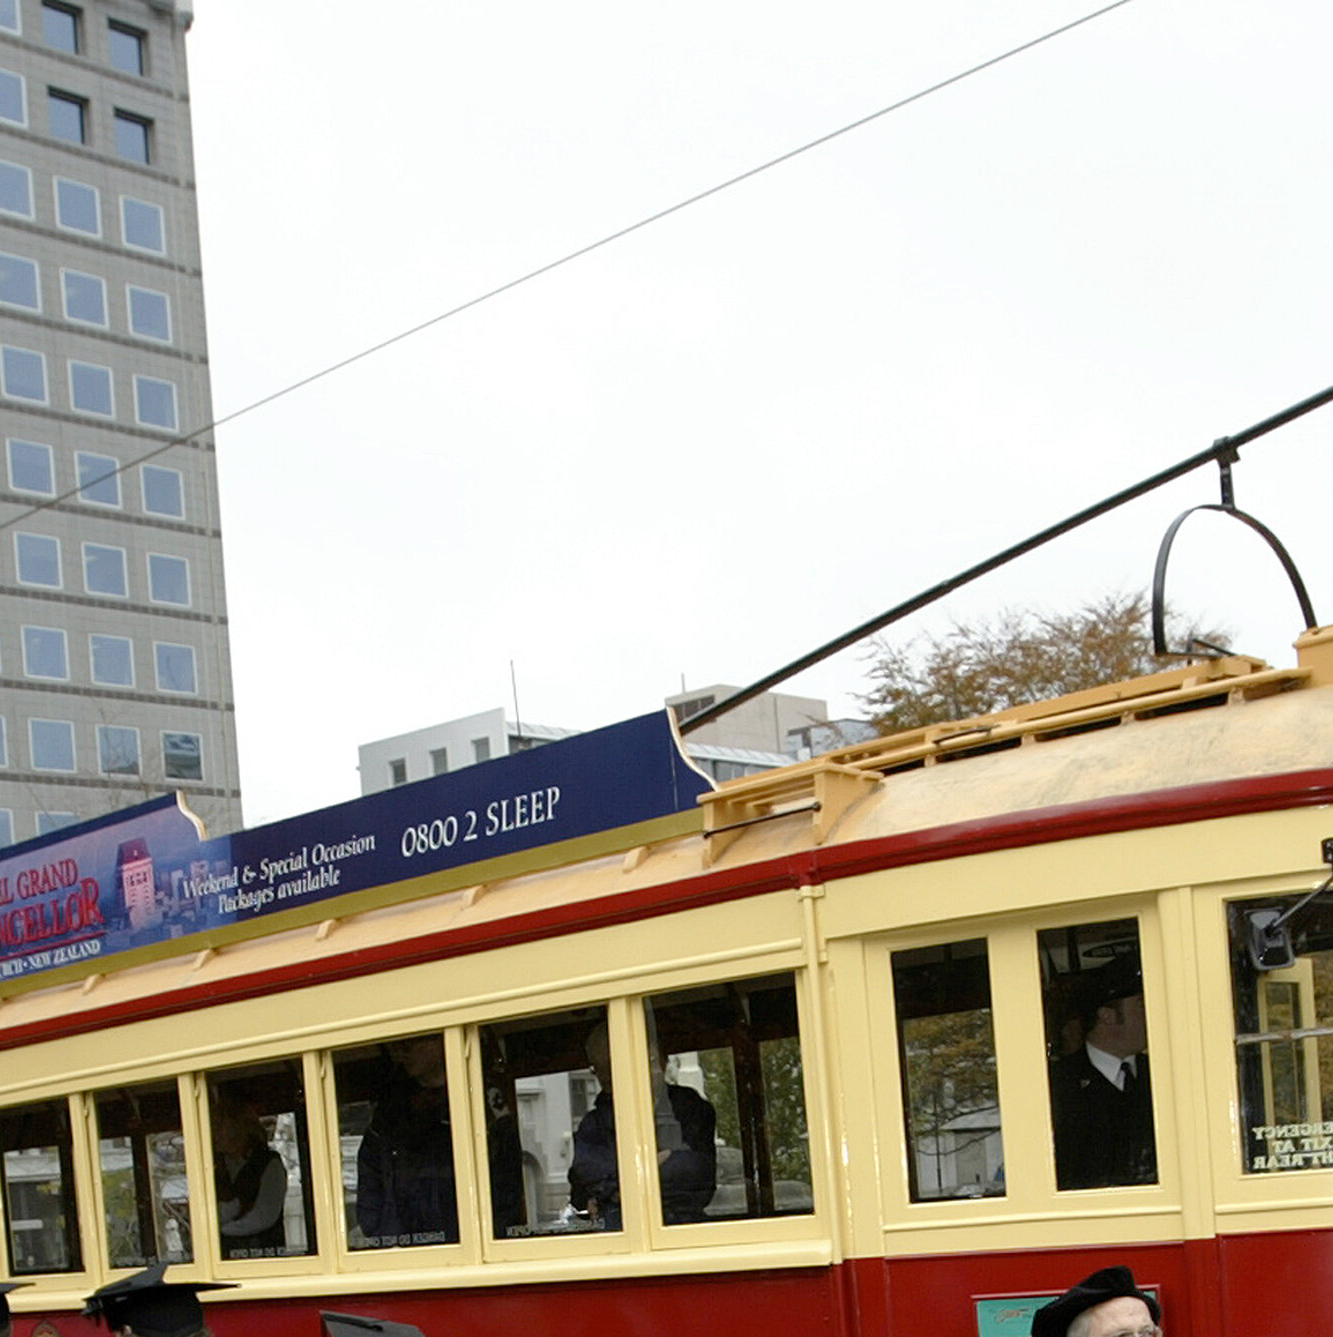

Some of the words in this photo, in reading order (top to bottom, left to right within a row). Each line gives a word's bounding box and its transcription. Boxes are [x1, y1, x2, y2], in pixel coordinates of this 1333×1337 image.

[401, 815, 458, 857] 0800
[463, 810, 478, 842] 2
[486, 785, 560, 837] SLEEP
[17, 858, 79, 897] GRAND
[184, 866, 238, 898] Weekend
[242, 865, 256, 884] &
[260, 847, 308, 884] Special
[312, 832, 375, 865] Occasion
[218, 885, 274, 913] Packages
[277, 864, 340, 899] available
[27, 952, 51, 970] NEW
[53, 939, 101, 963] ZEALAND
